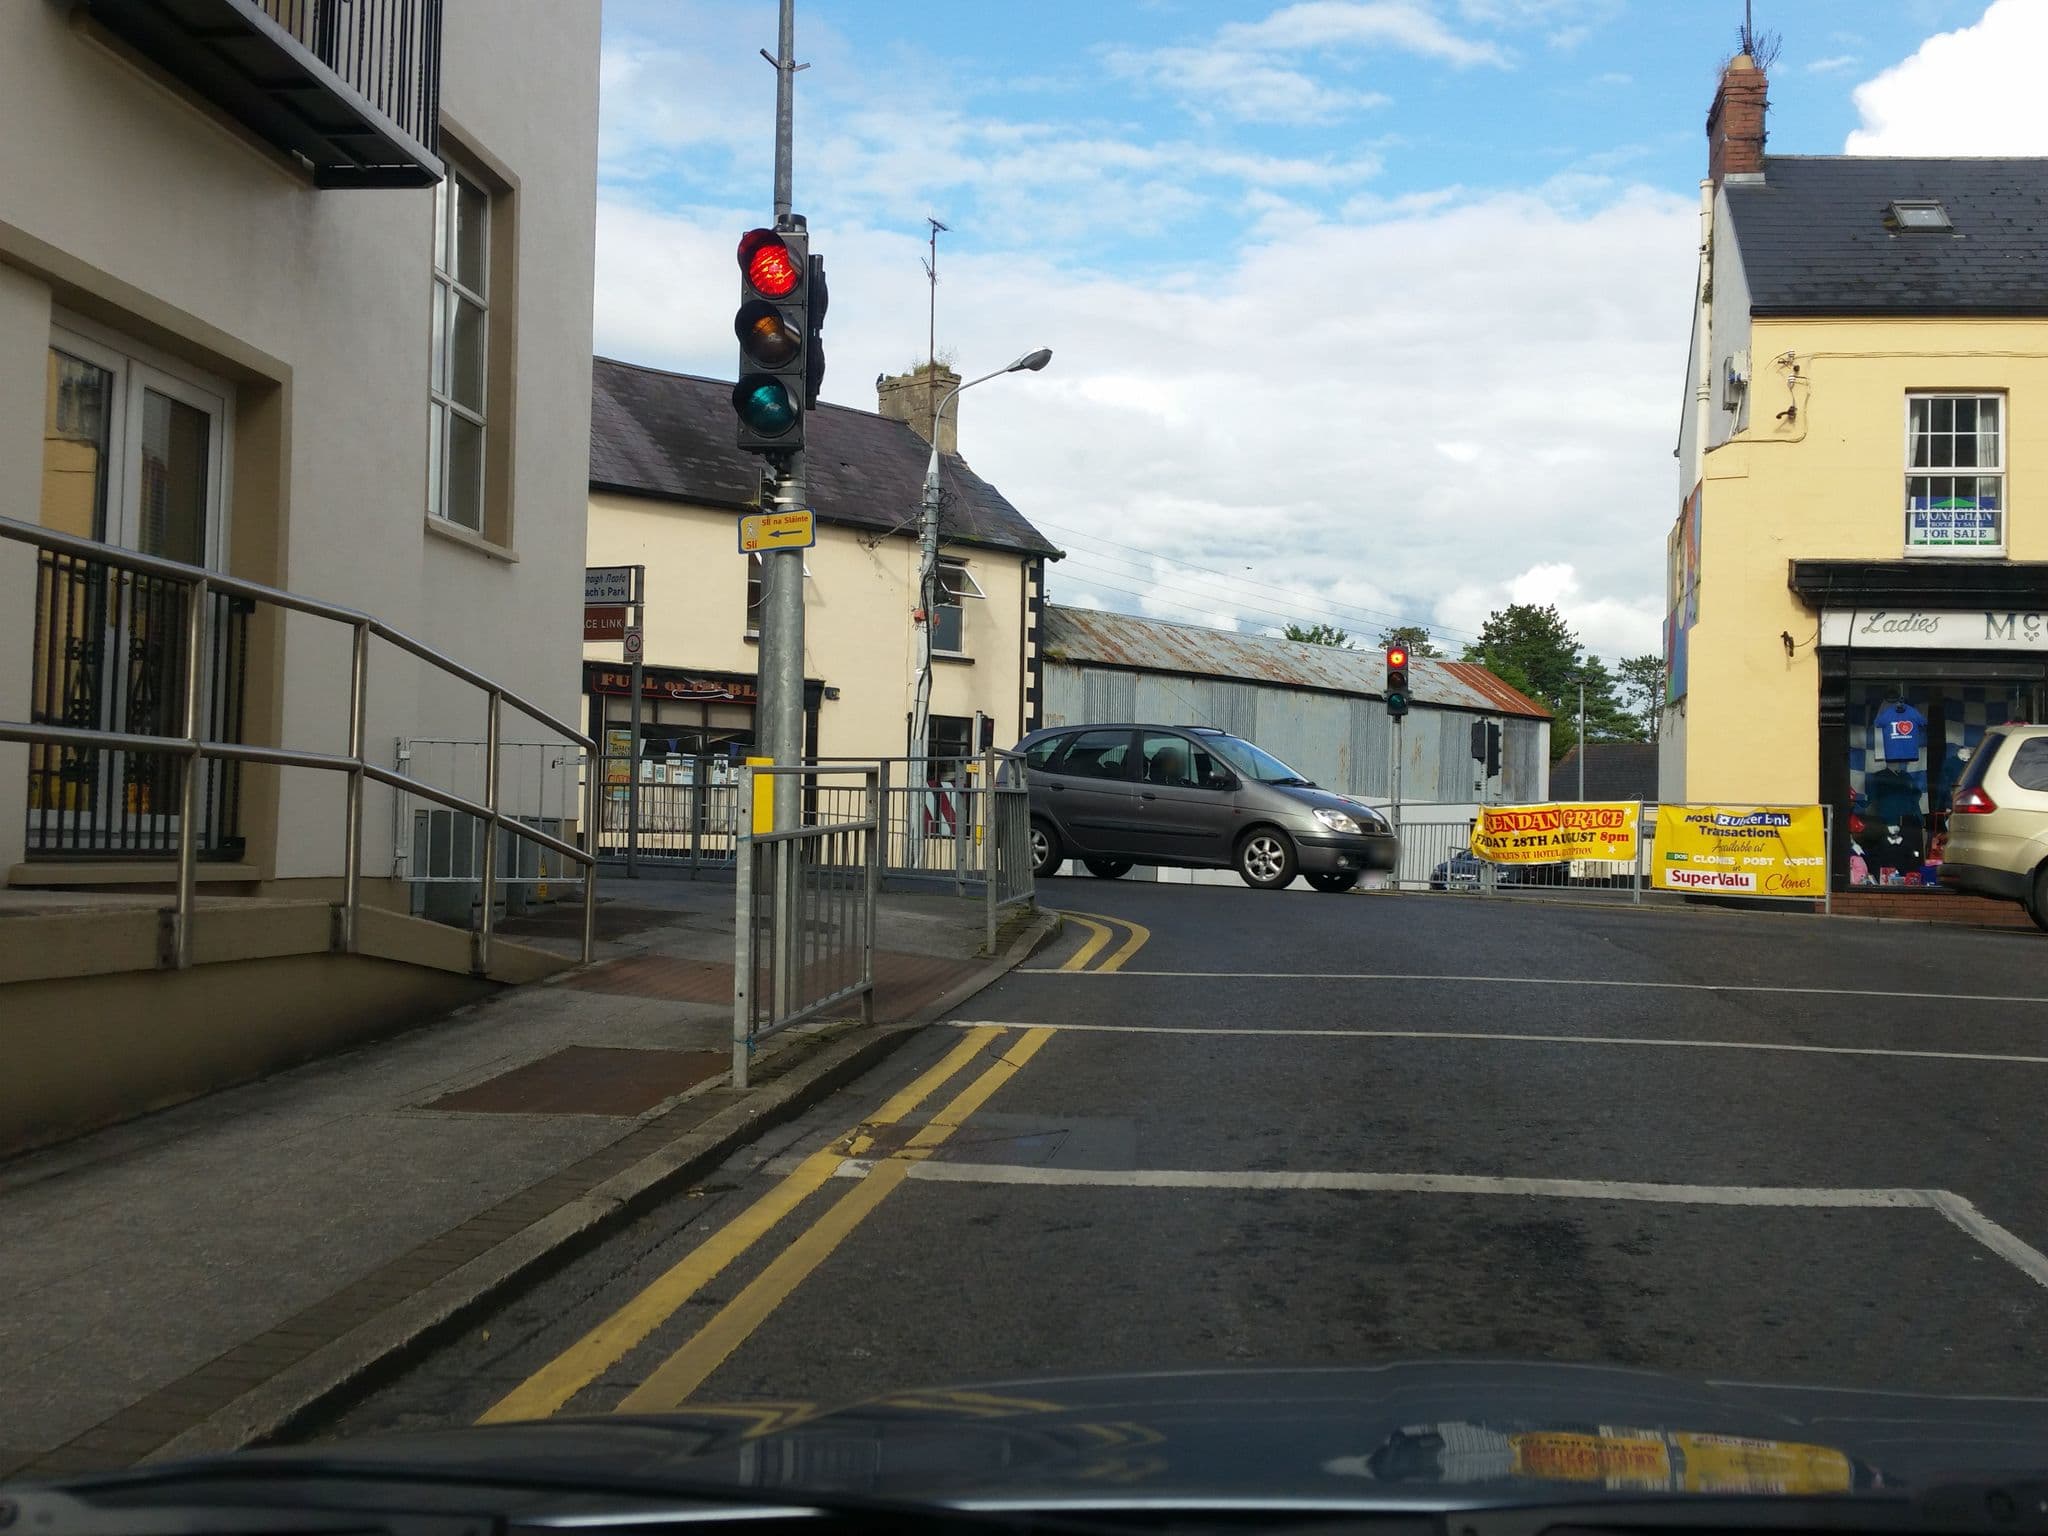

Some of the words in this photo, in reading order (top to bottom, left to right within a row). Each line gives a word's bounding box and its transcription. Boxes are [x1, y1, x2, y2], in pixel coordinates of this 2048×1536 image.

[1923, 529, 1949, 539] FOR
[1954, 529, 1987, 539] SALE
[607, 586, 626, 597] Park
[584, 618, 598, 629] CE
[601, 618, 624, 629] LINK
[1861, 611, 1942, 635] Ladies
[600, 672, 658, 690] FUL
[727, 683, 758, 697] BL
[1562, 809, 1624, 831] GRACE
[1512, 835, 1548, 848] 28TH
[1600, 831, 1629, 845] 8pm
[1712, 840, 1753, 853] Available
[1743, 857, 1775, 866] POST
[1672, 869, 1750, 887] SuperValu
[1765, 873, 1812, 891] Clones
